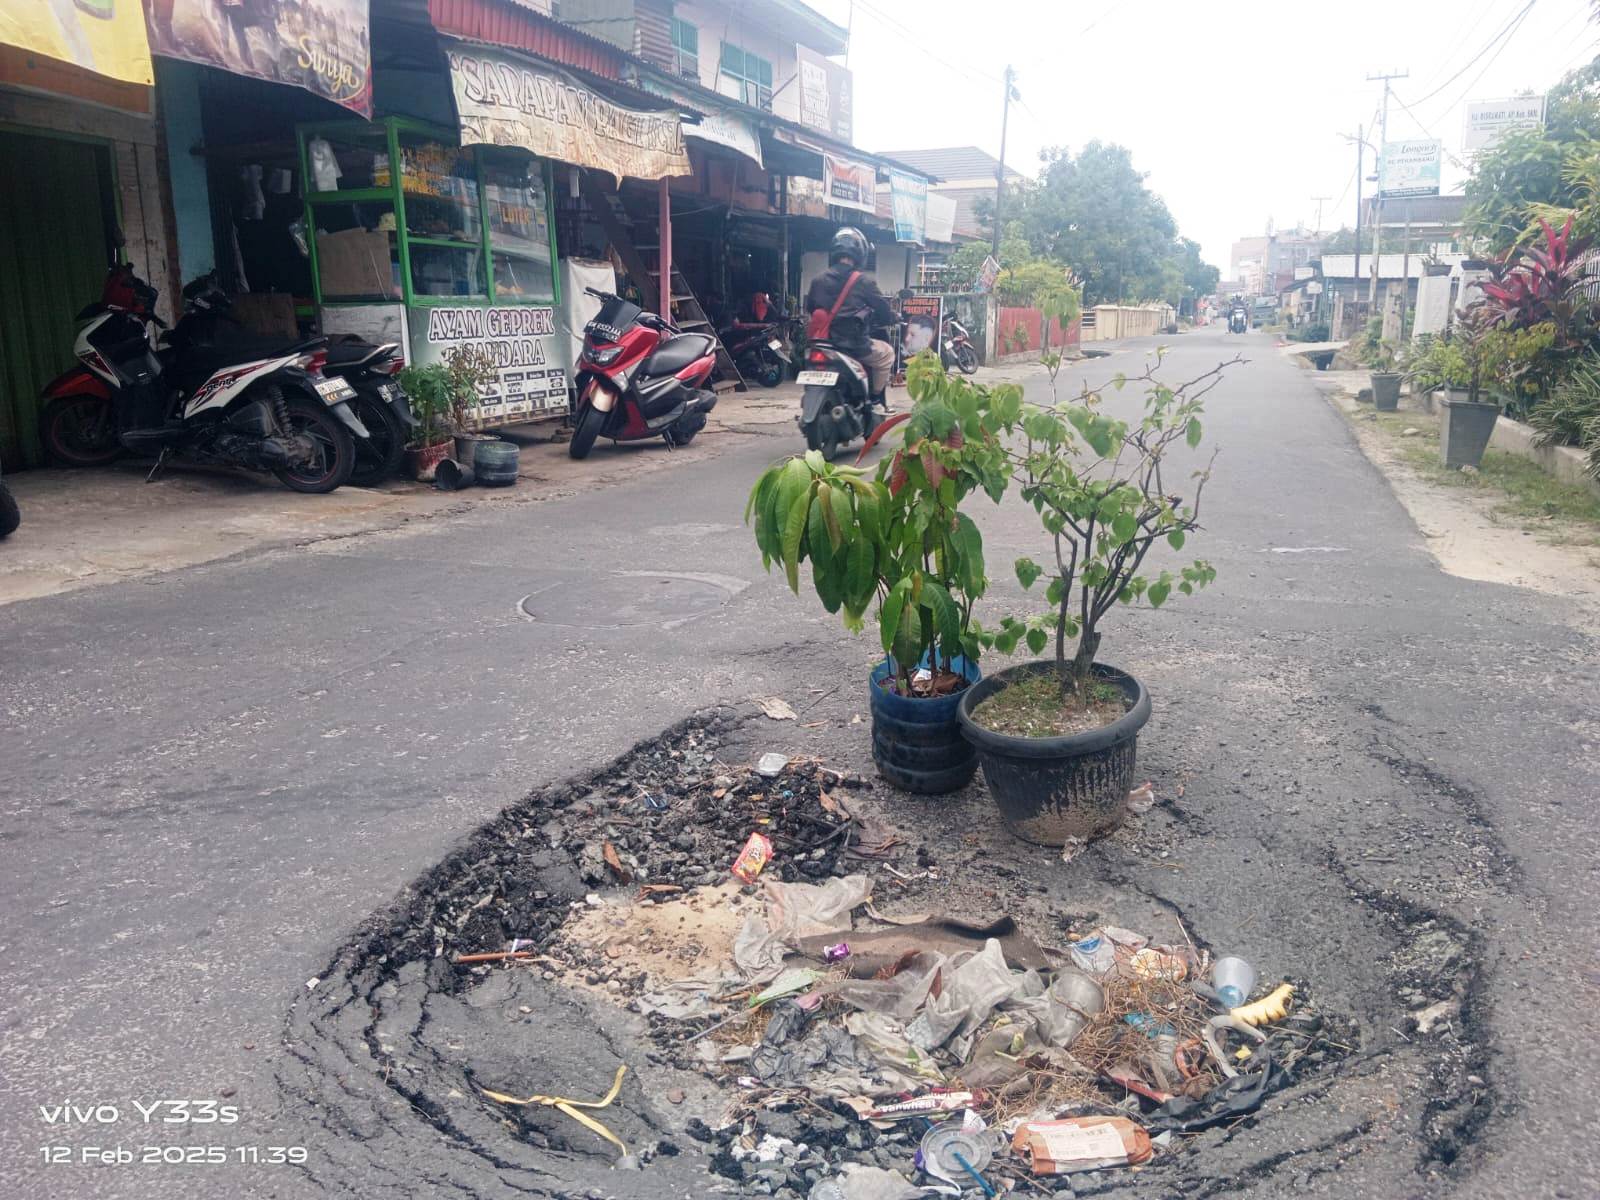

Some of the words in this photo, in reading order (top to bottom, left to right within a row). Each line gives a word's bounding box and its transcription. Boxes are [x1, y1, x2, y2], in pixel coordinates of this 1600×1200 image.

[297, 35, 361, 94] Surya
[429, 309, 485, 341] AYAM
[486, 307, 555, 338] GEPREK
